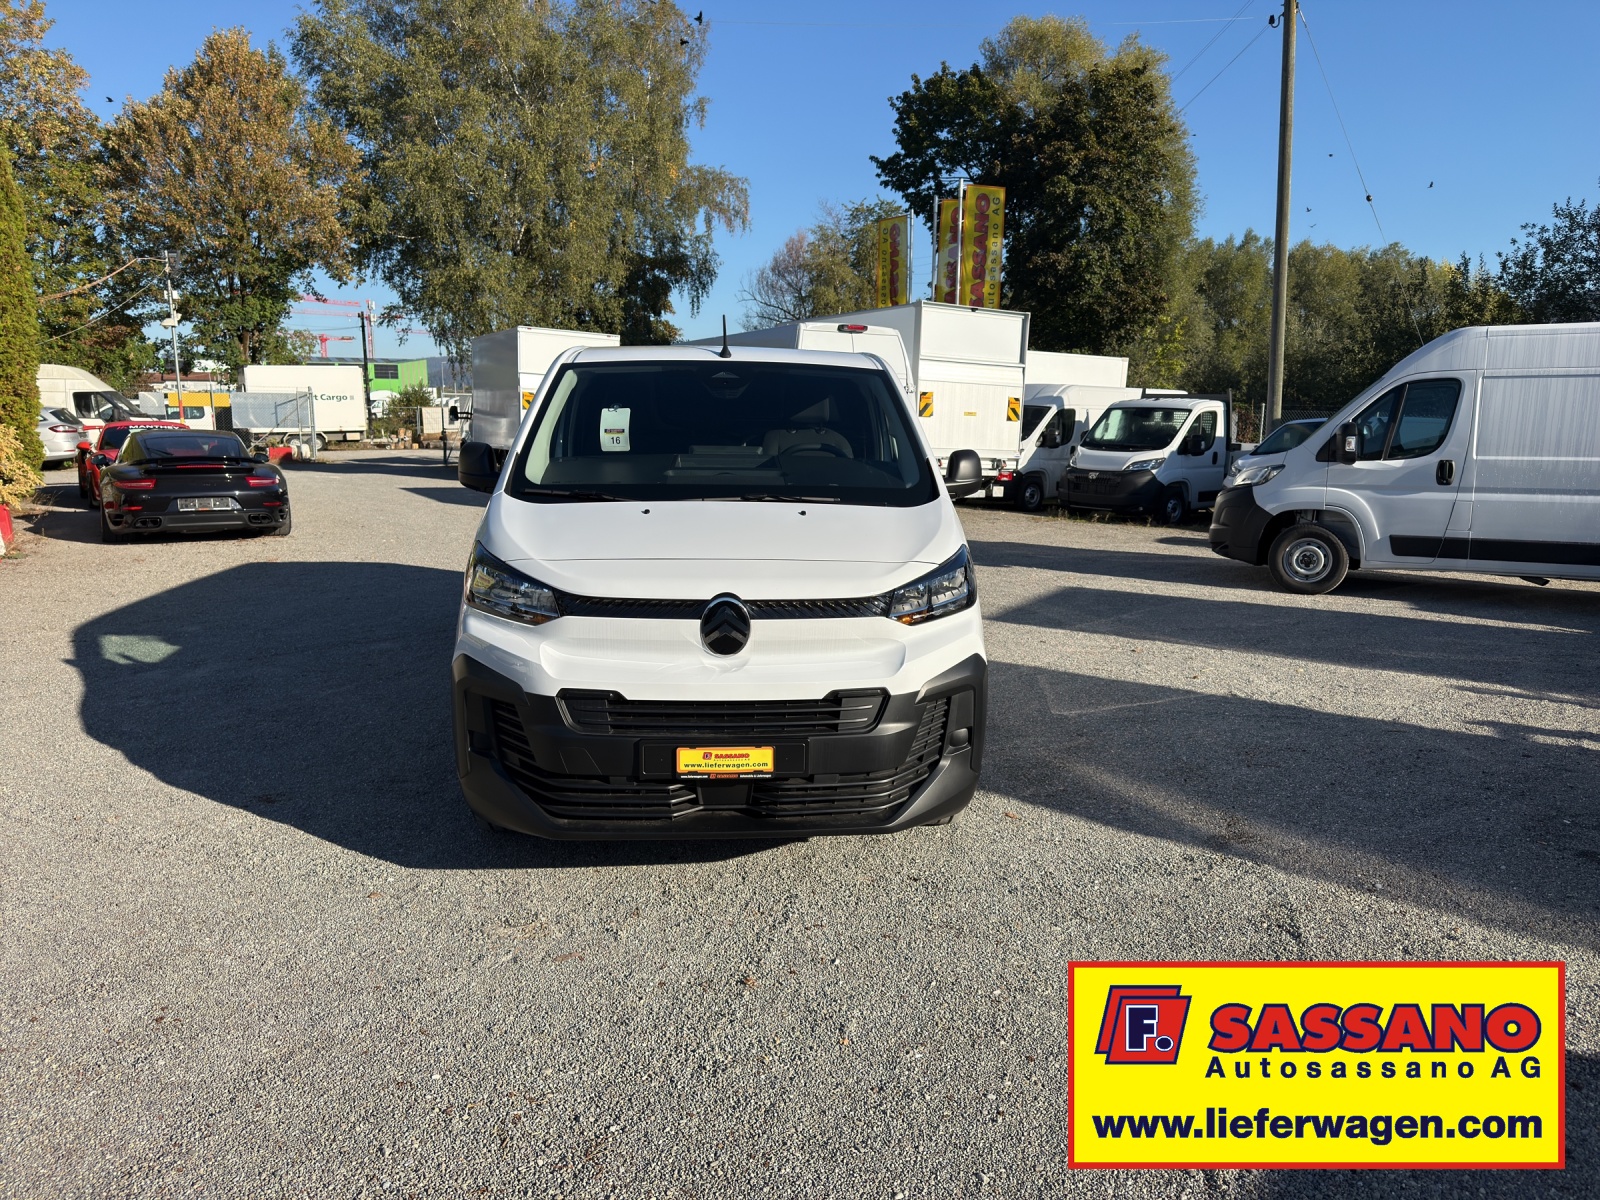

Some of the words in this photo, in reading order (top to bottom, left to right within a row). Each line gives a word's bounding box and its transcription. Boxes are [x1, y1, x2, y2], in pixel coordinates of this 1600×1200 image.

[993, 197, 1001, 216] AG
[988, 223, 999, 307] utosassano
[320, 393, 348, 402] Cargo
